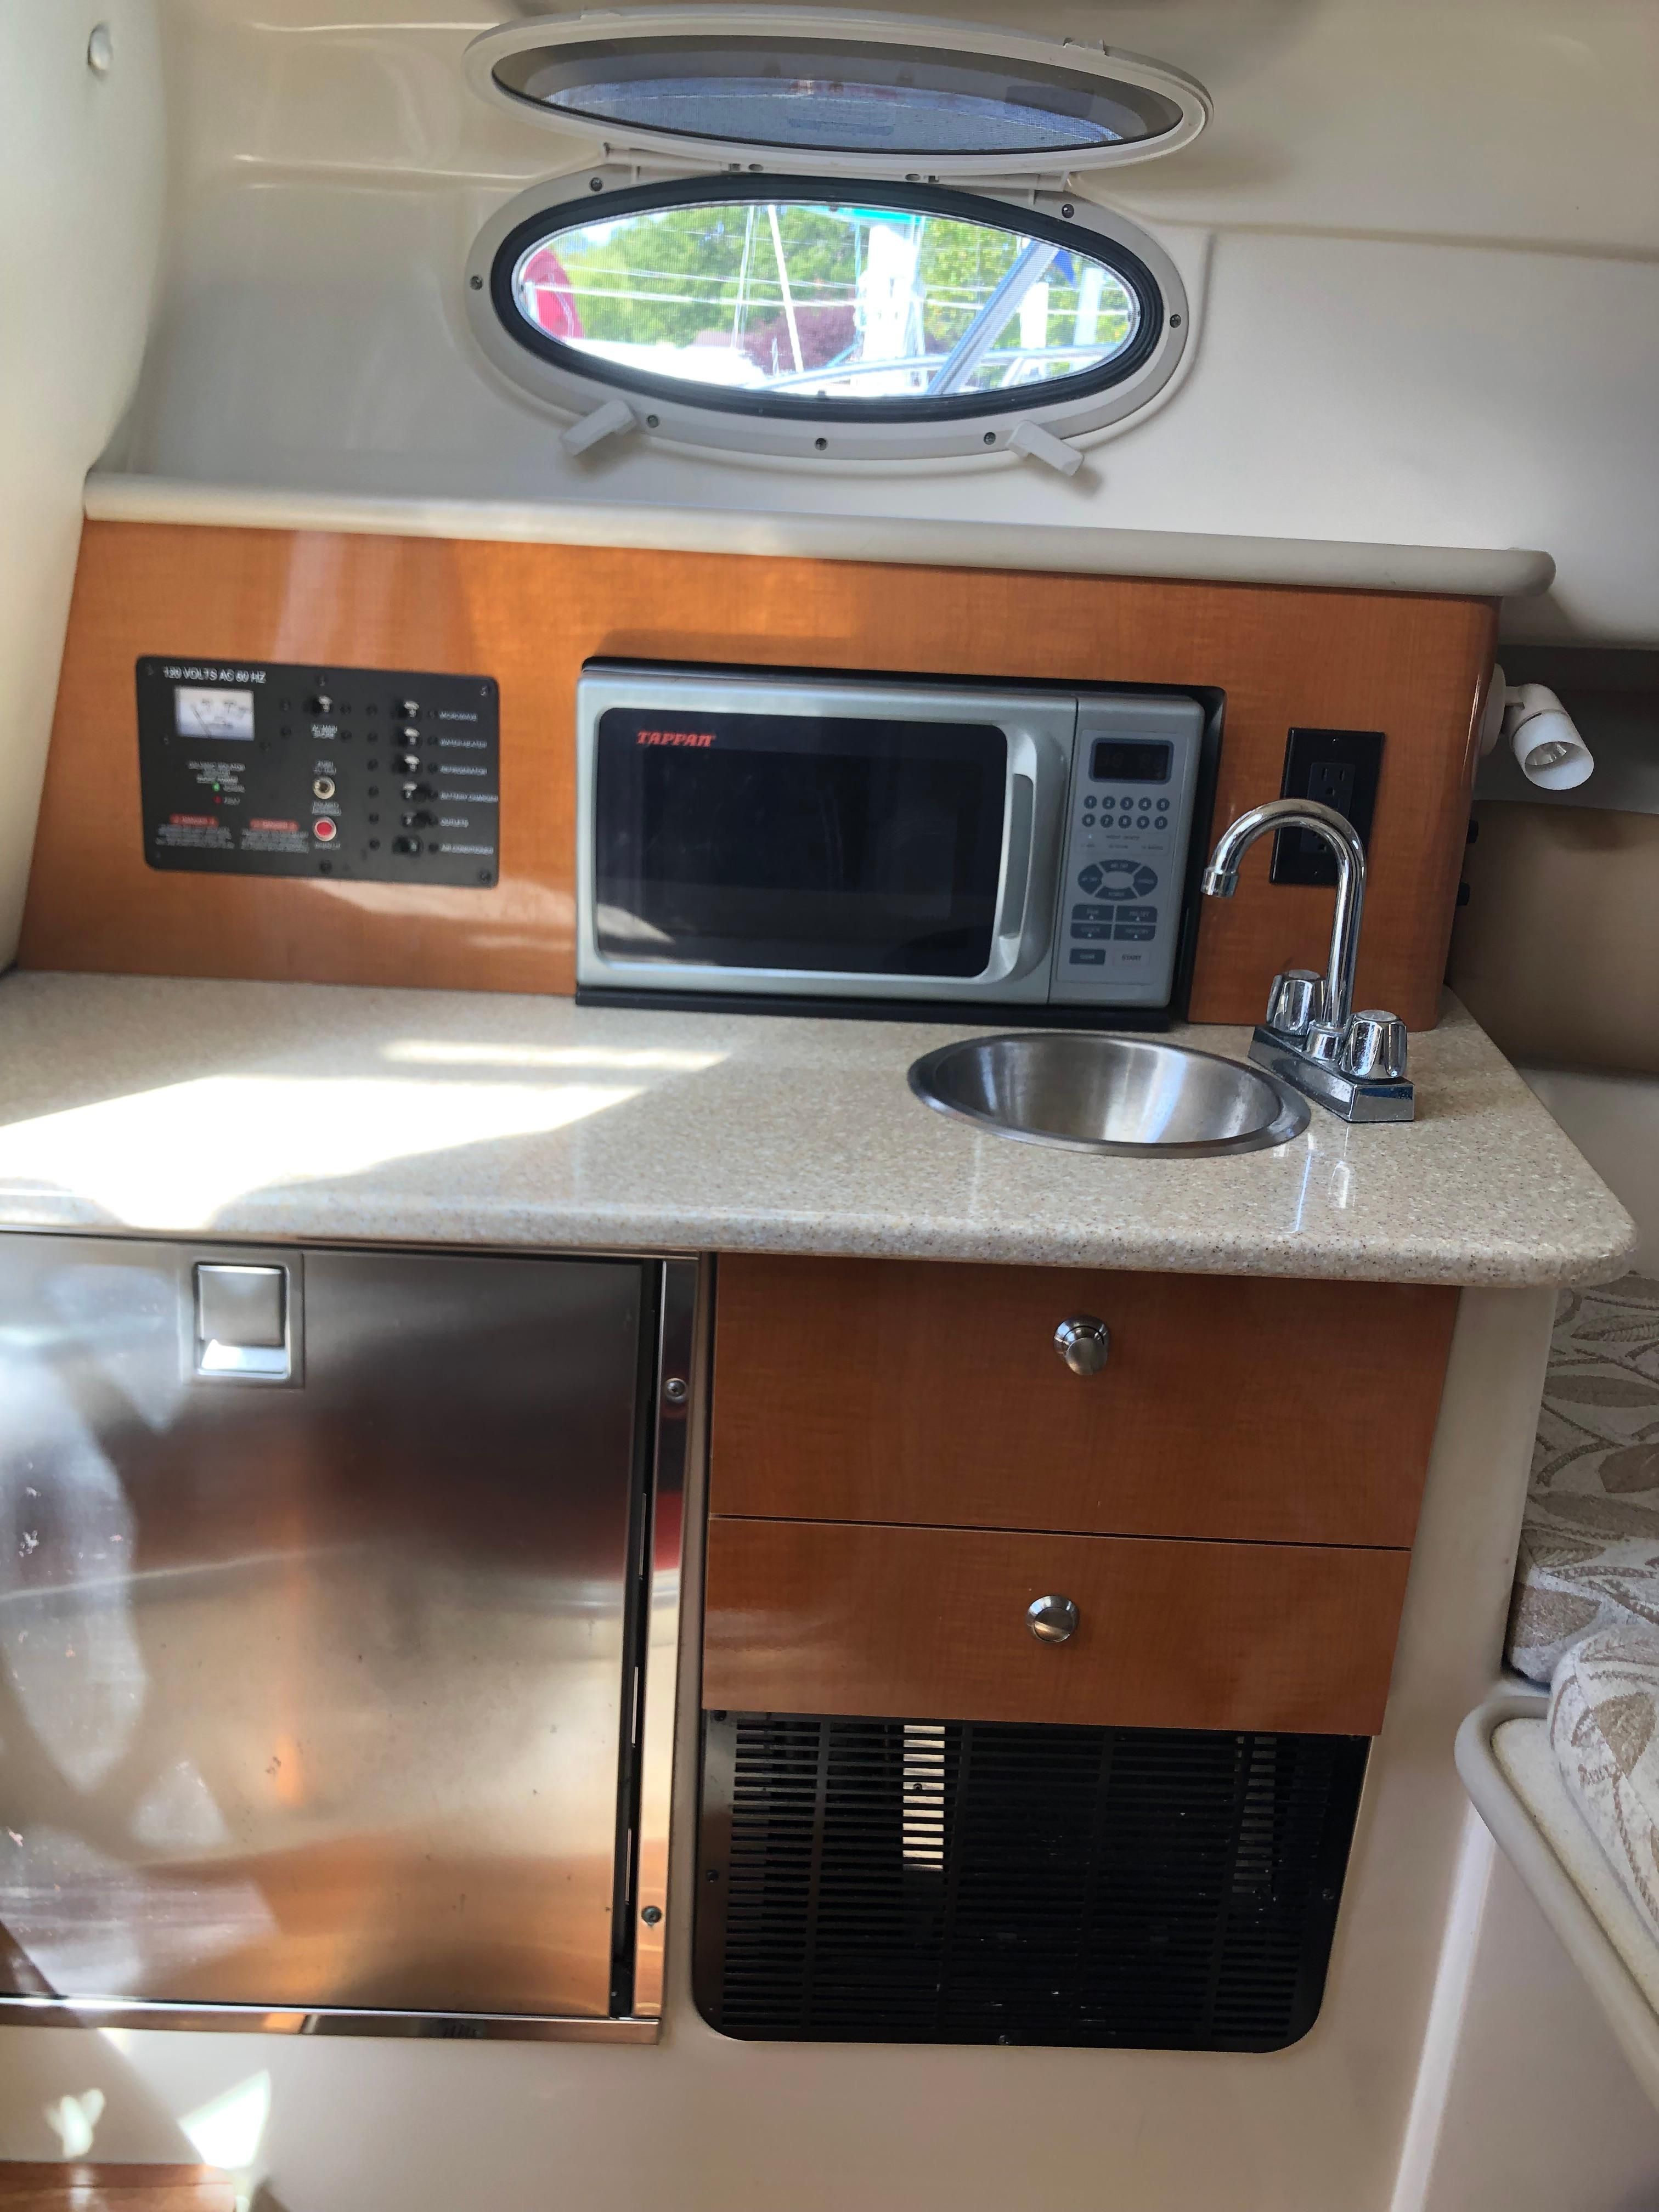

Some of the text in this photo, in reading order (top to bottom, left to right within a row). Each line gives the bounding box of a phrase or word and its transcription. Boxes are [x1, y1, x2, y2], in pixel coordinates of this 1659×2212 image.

[183, 667, 217, 681] VOLTS
[219, 669, 234, 682] AC
[251, 671, 267, 684] HZ
[637, 730, 713, 747] TAPPAN
